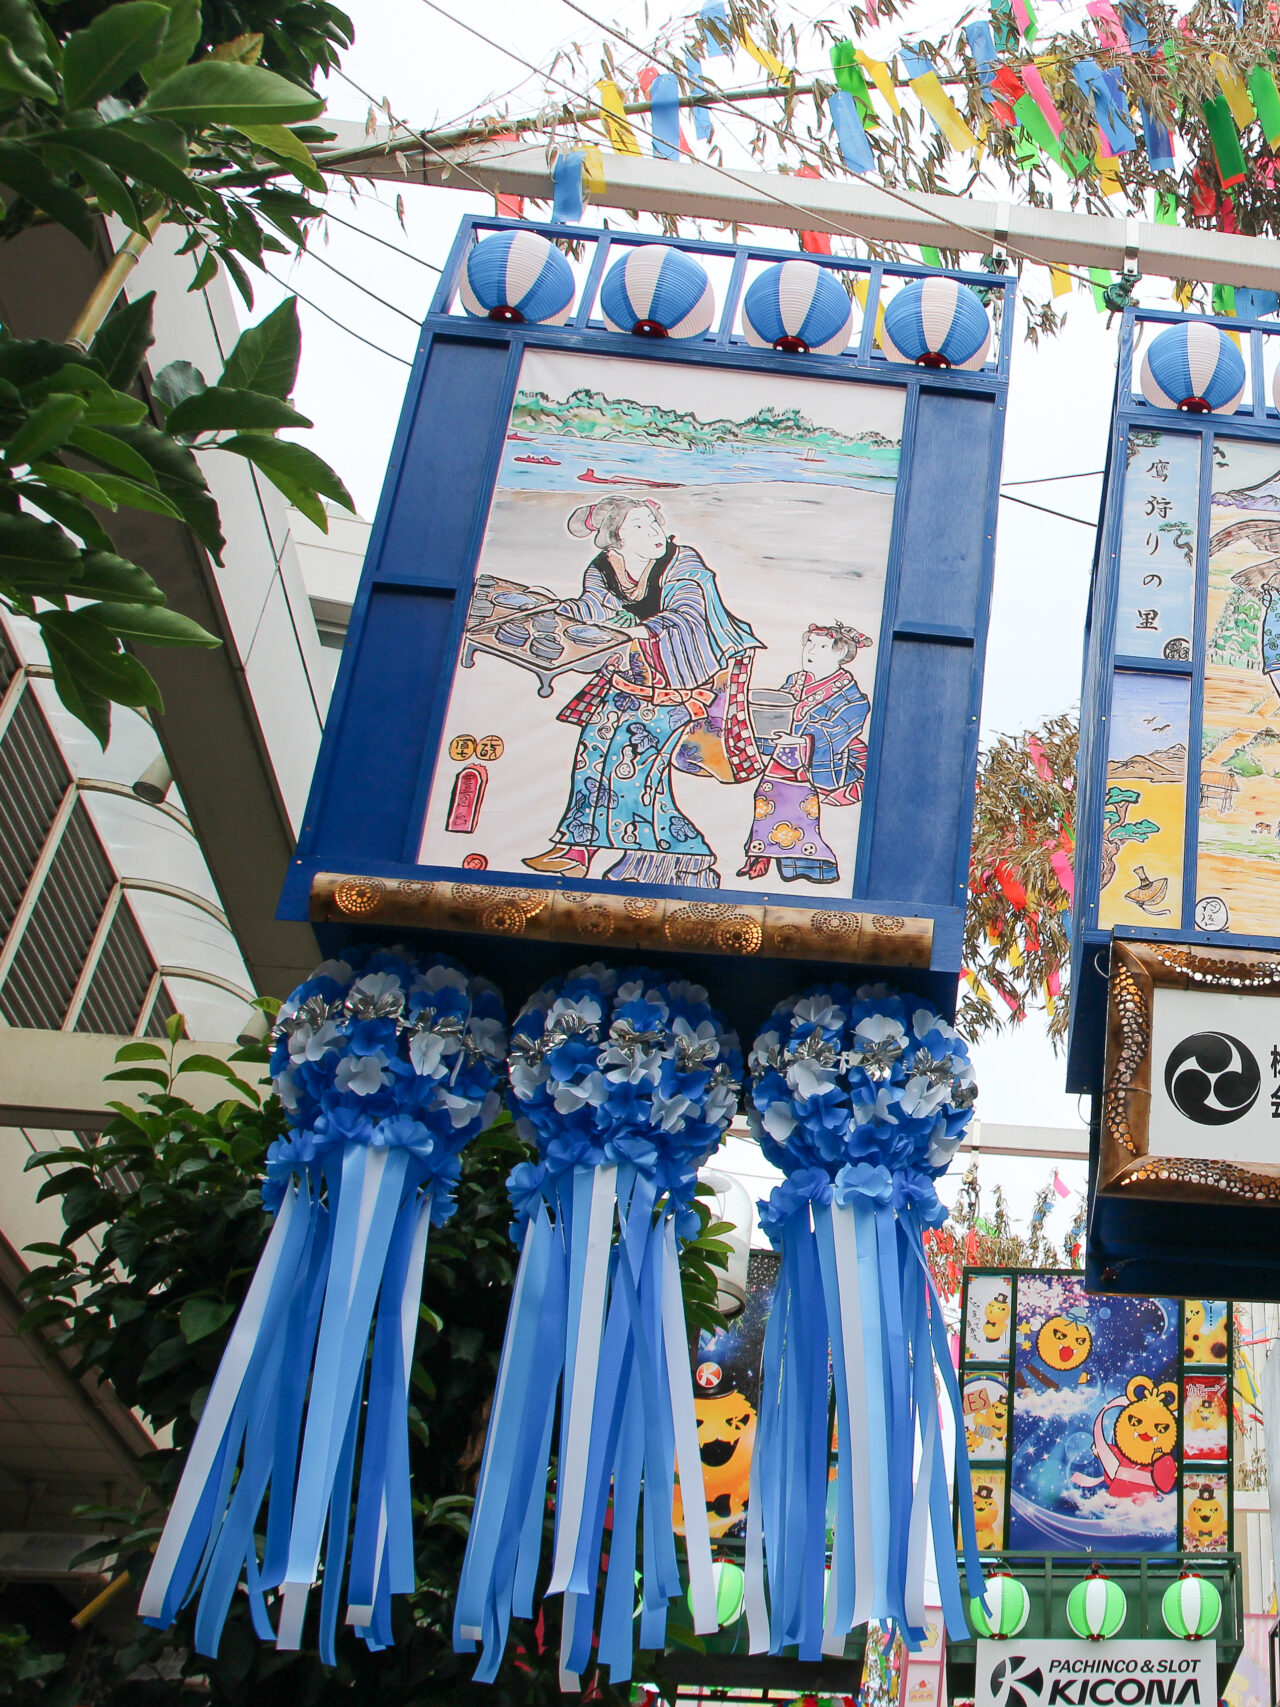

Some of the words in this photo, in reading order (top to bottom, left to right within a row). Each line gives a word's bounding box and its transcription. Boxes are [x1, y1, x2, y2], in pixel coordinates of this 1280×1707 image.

[1135, 459, 1173, 631] 鷹狩りの里
[1048, 1659, 1138, 1674] PACHINCO
[1140, 1660, 1155, 1673] &
[1156, 1659, 1201, 1673] SLOT
[1047, 1678, 1201, 1706] KICONA
